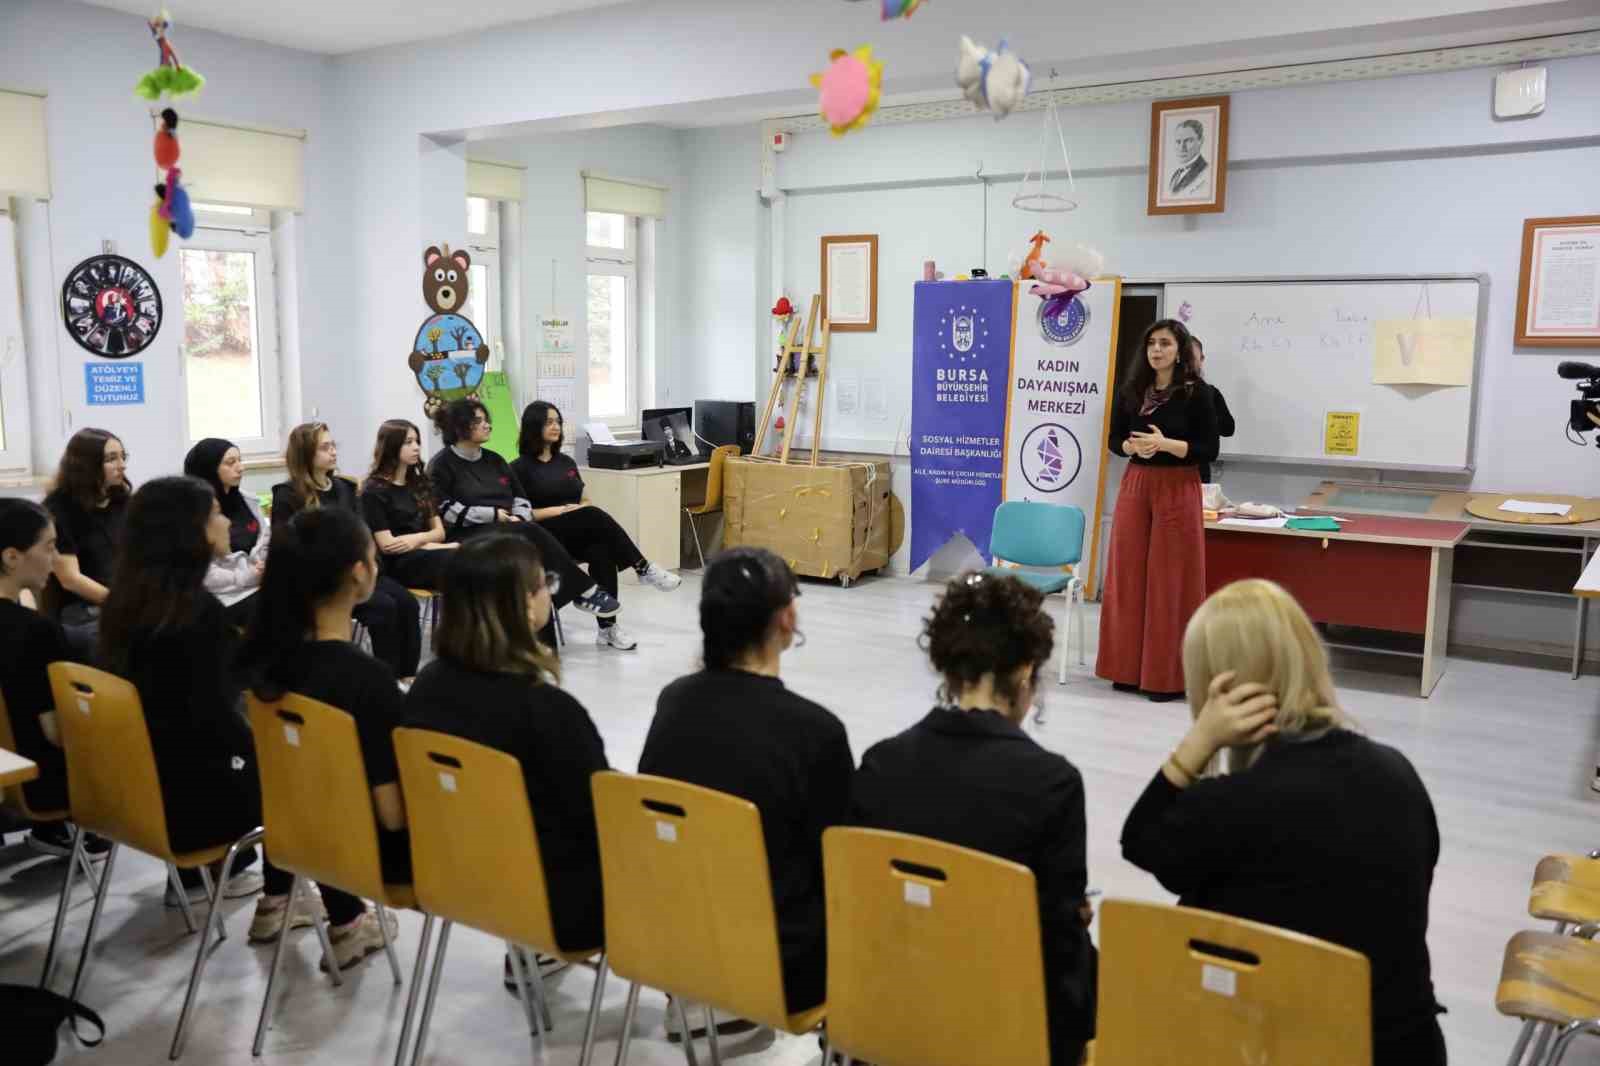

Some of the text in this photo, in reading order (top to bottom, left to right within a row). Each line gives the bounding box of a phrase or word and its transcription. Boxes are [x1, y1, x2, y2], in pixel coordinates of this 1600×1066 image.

[1037, 360, 1080, 373] KADIN
[936, 368, 988, 381] BURSA
[936, 381, 988, 392] BÜYÜKŞEHİR
[1017, 378, 1099, 396] DAYANIŞMA
[93, 393, 138, 402] TUTUNUZ
[936, 392, 989, 402] BELEDİYESİ
[1027, 400, 1086, 415] MERKEZİ
[922, 435, 1001, 446] SOSYAL HİZMETLER
[920, 446, 952, 456] DAİRESİ
